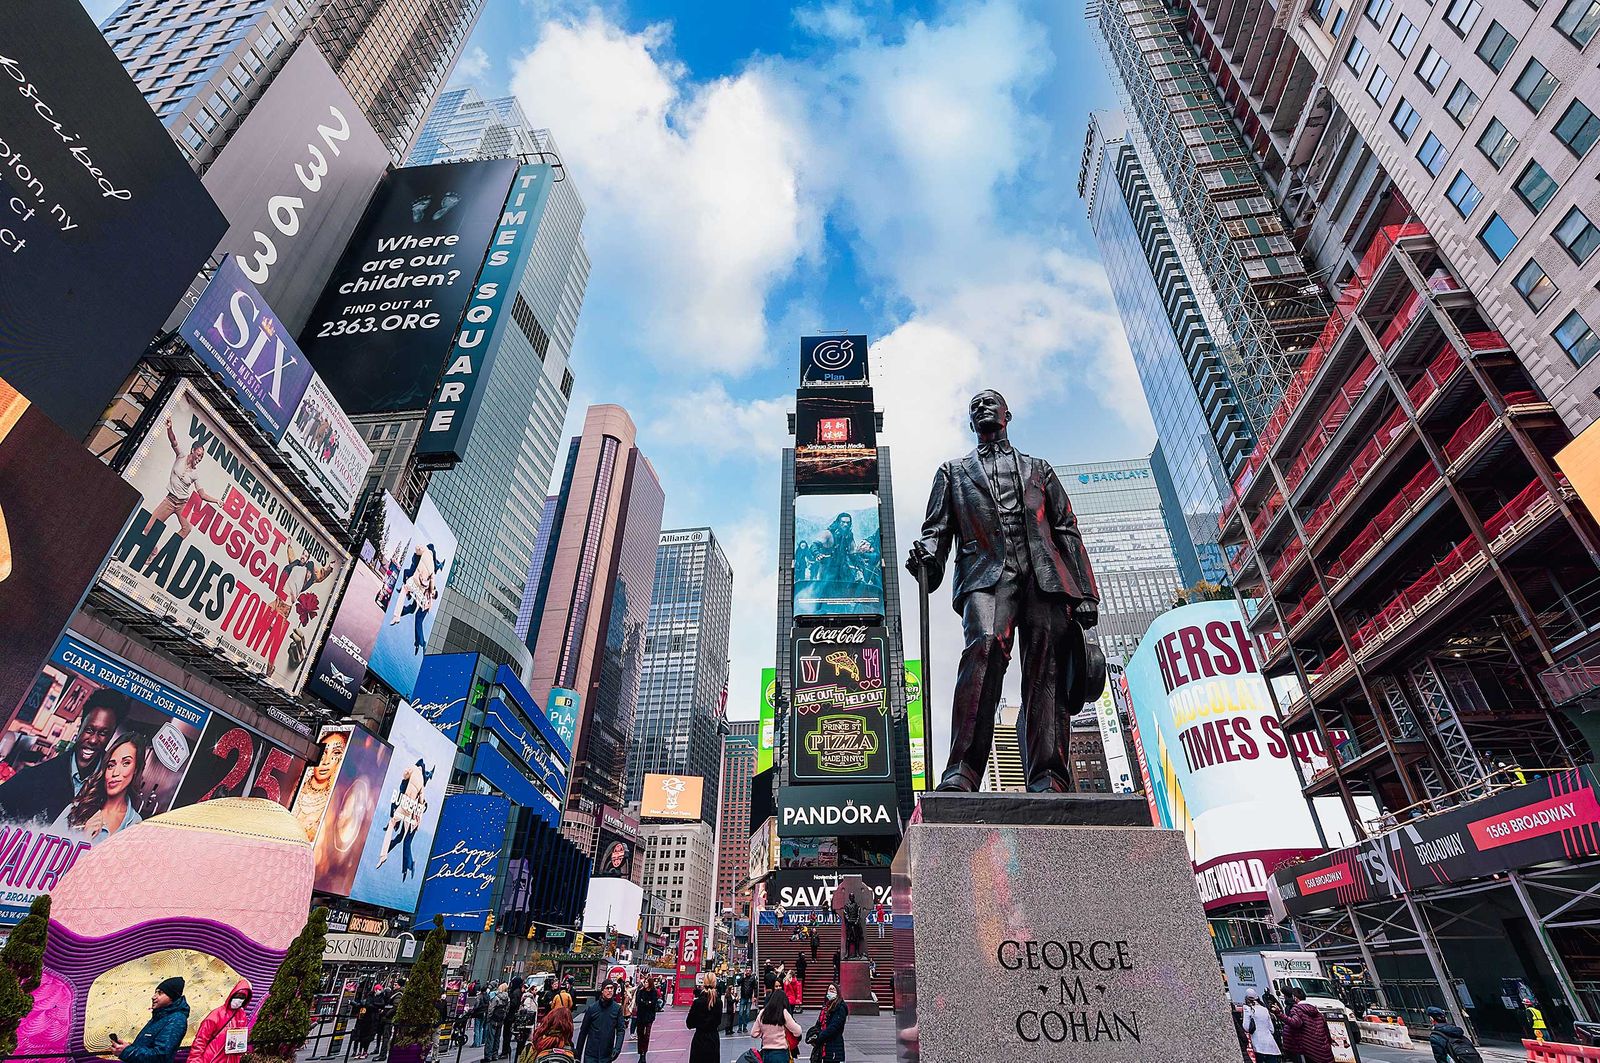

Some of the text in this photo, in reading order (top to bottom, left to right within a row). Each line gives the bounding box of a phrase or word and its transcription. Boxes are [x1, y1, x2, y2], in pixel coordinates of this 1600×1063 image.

[10, 197, 35, 221] ct
[51, 203, 78, 231] ny
[484, 173, 537, 266] TIMES
[0, 228, 26, 253] ct
[377, 234, 460, 253] Where
[362, 252, 456, 273] are our
[339, 269, 461, 295] children?
[342, 299, 433, 316] FIND OUT AT
[316, 312, 442, 338] 2363.ORG
[213, 290, 298, 408] SIX
[429, 282, 498, 432] SQUARE
[223, 346, 239, 367] THE
[238, 365, 267, 402] MUSICAL
[824, 373, 845, 381] Plan
[806, 441, 866, 451] Xinhua Screen Media
[1092, 470, 1150, 483] BARCLAYS
[189, 414, 270, 511] WINNER!
[267, 497, 278, 513] 8
[276, 502, 301, 536] TONY
[296, 526, 331, 567] AWARDS
[222, 486, 288, 556] BEST
[181, 491, 289, 601] MUSICAL
[661, 534, 690, 543] Allianz
[809, 625, 868, 645] Coca-Cola
[62, 650, 202, 724] CIARA RENÉE WITH JOSH HENRY
[126, 670, 161, 692] STARRING
[320, 675, 352, 700] ARCIMOTO
[796, 690, 885, 705] TAKE OUT TO HELP OUT
[270, 706, 296, 727] OUTFRONT
[550, 711, 575, 728] PLAY
[822, 722, 861, 731] PRINCE ST
[1107, 719, 1118, 734] SF
[158, 736, 181, 765] BAREILLES
[167, 734, 179, 751] SARA
[810, 735, 874, 751] PIZZA
[1136, 737, 1150, 766] COME
[1178, 715, 1260, 774] TIMES
[196, 726, 294, 806] 25
[821, 755, 865, 763] MADE IN NYC
[783, 802, 891, 825] PANDORA
[1485, 802, 1577, 839] 1568 BROADWAY
[432, 840, 501, 862] happy
[1355, 826, 1408, 895] TSX
[1414, 832, 1466, 866] BROADWAY
[1214, 858, 1268, 898] WORLD
[1304, 869, 1344, 889] 1568 BROADWAY
[339, 911, 350, 924] FIN
[350, 938, 400, 959] SWAROVSKI
[683, 928, 700, 962] tkts
[997, 940, 1133, 971] GEORGE
[1058, 975, 1091, 1006] M
[1016, 1010, 1142, 1044] COHAN
